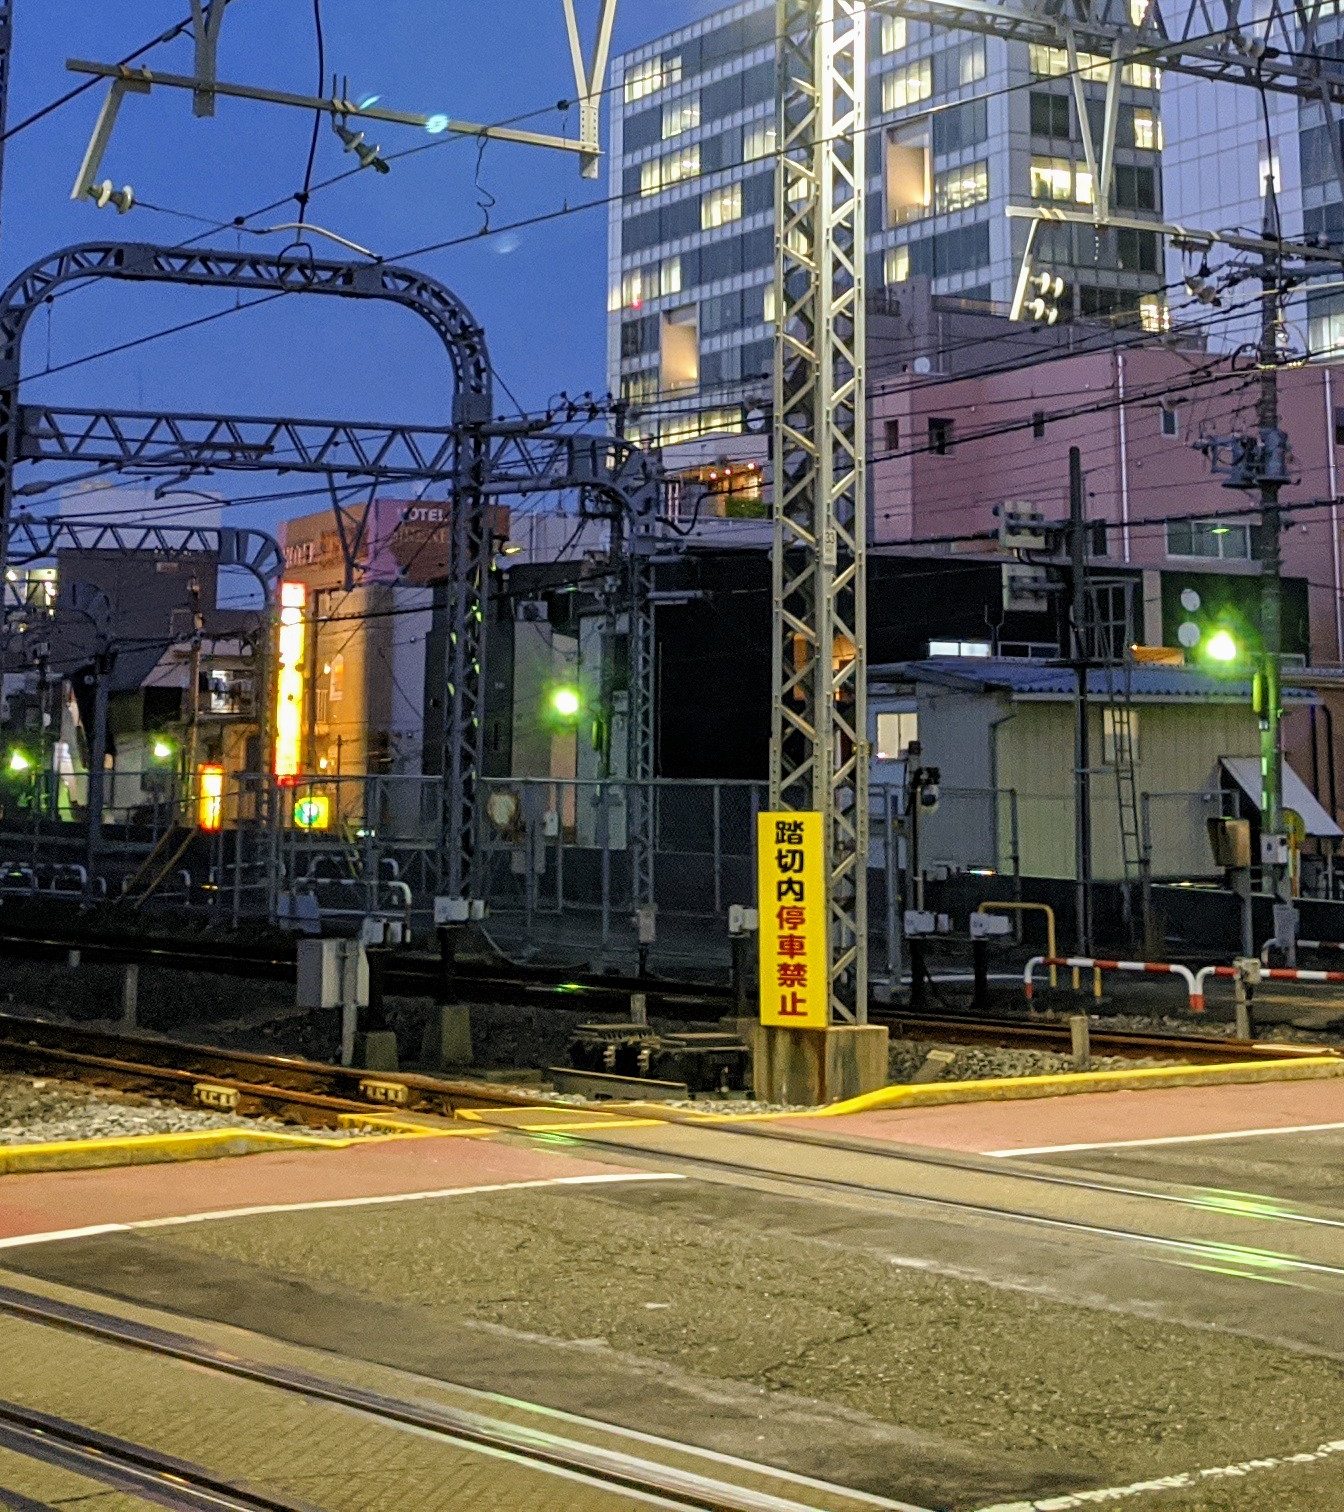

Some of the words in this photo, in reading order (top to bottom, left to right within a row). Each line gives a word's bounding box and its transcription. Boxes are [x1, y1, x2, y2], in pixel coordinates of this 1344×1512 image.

[775, 820, 808, 1017] 踏切内停車禁止
